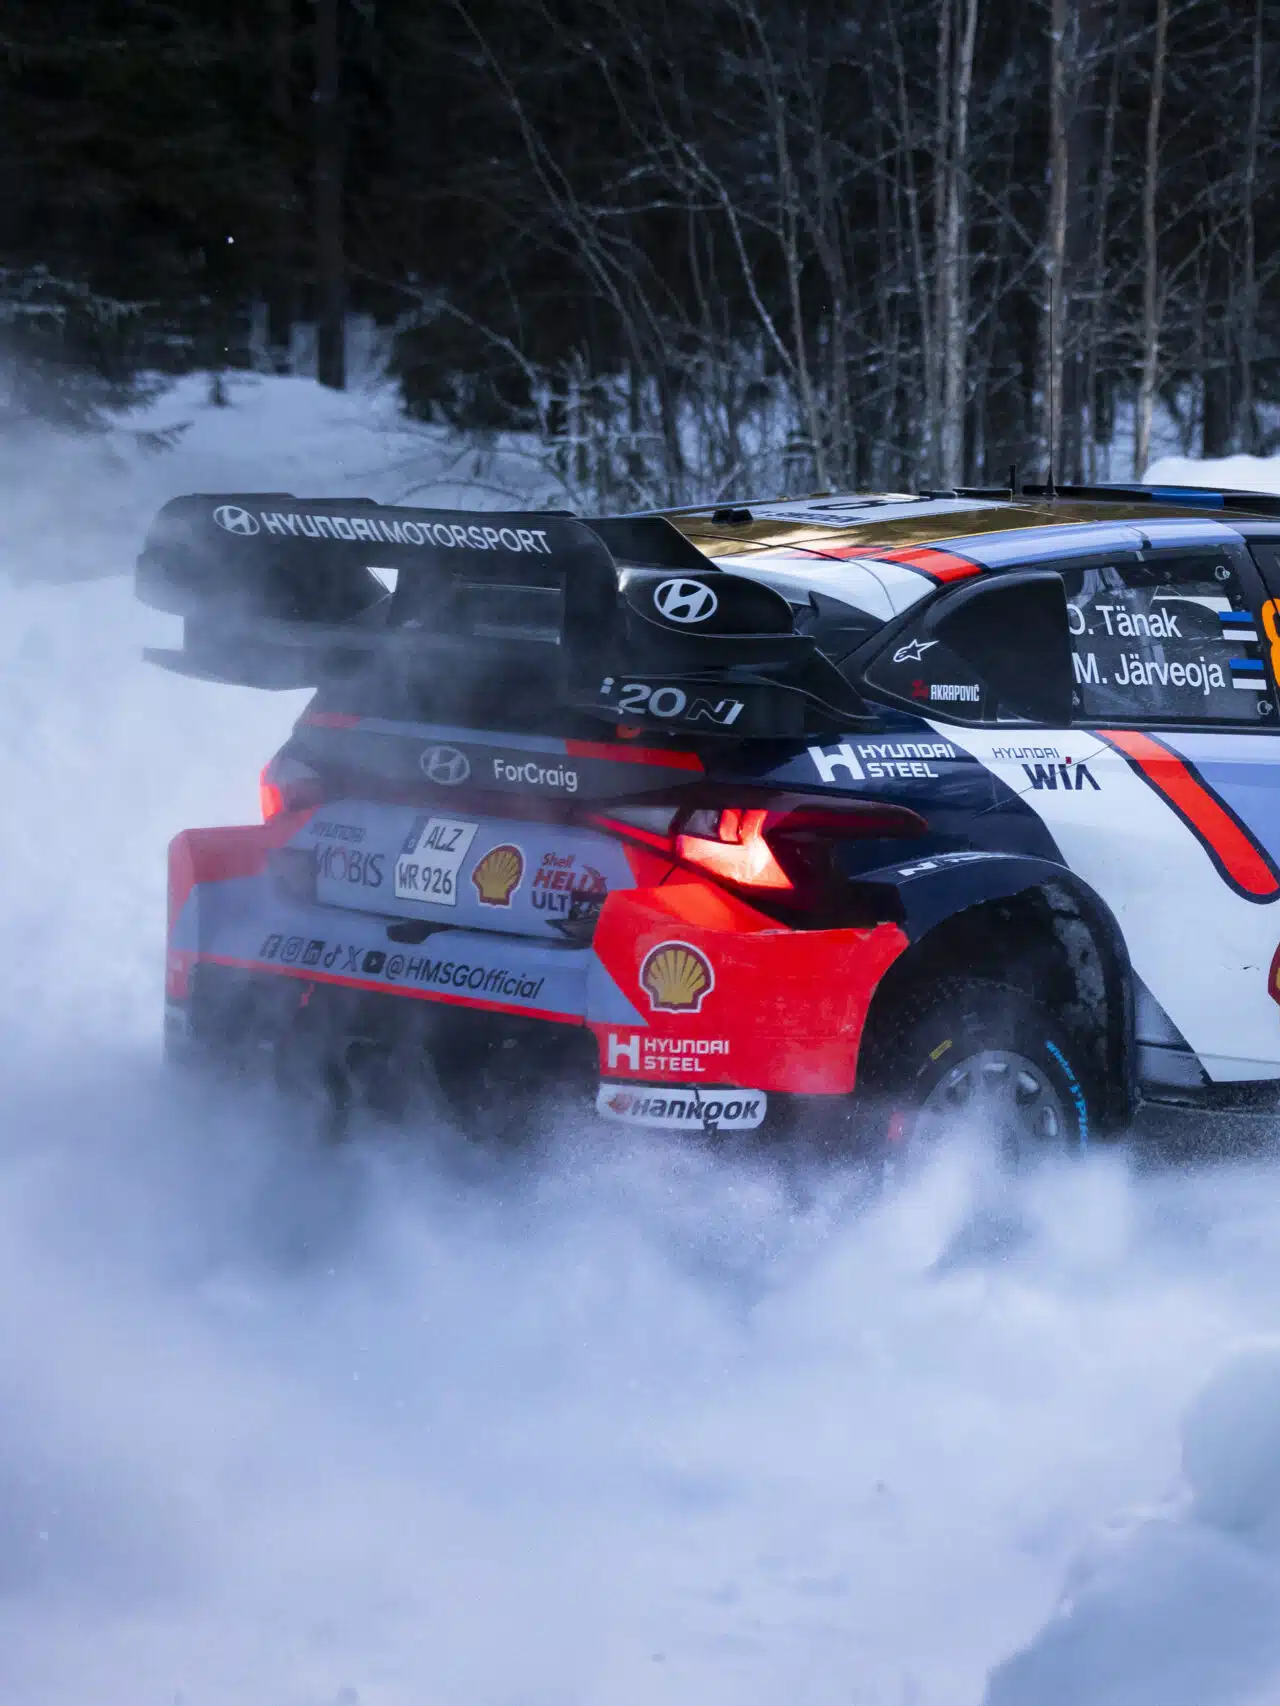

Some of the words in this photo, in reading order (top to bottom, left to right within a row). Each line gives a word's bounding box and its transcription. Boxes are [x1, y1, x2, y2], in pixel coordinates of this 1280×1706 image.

[260, 512, 383, 542] HYUNDAI
[379, 519, 552, 554] MOTORSPORT
[1096, 604, 1183, 638] Tänak
[1071, 652, 1108, 685] M.
[1115, 653, 1226, 695] Järveoja
[930, 684, 980, 702] AKRAPOVIČ
[857, 743, 956, 759] HYUNDAI
[991, 747, 1060, 760] HYUNDAI
[493, 758, 578, 792] ForCraig
[866, 762, 939, 779] STEEL
[423, 825, 465, 852] ALZ
[542, 851, 576, 868] Shell
[399, 862, 420, 890] WR
[422, 867, 453, 895] 926
[532, 891, 569, 913] ULT
[385, 955, 545, 1000] @HMSGOfficial
[644, 1038, 730, 1055] HYUNDAI
[644, 1056, 706, 1072] STEEL
